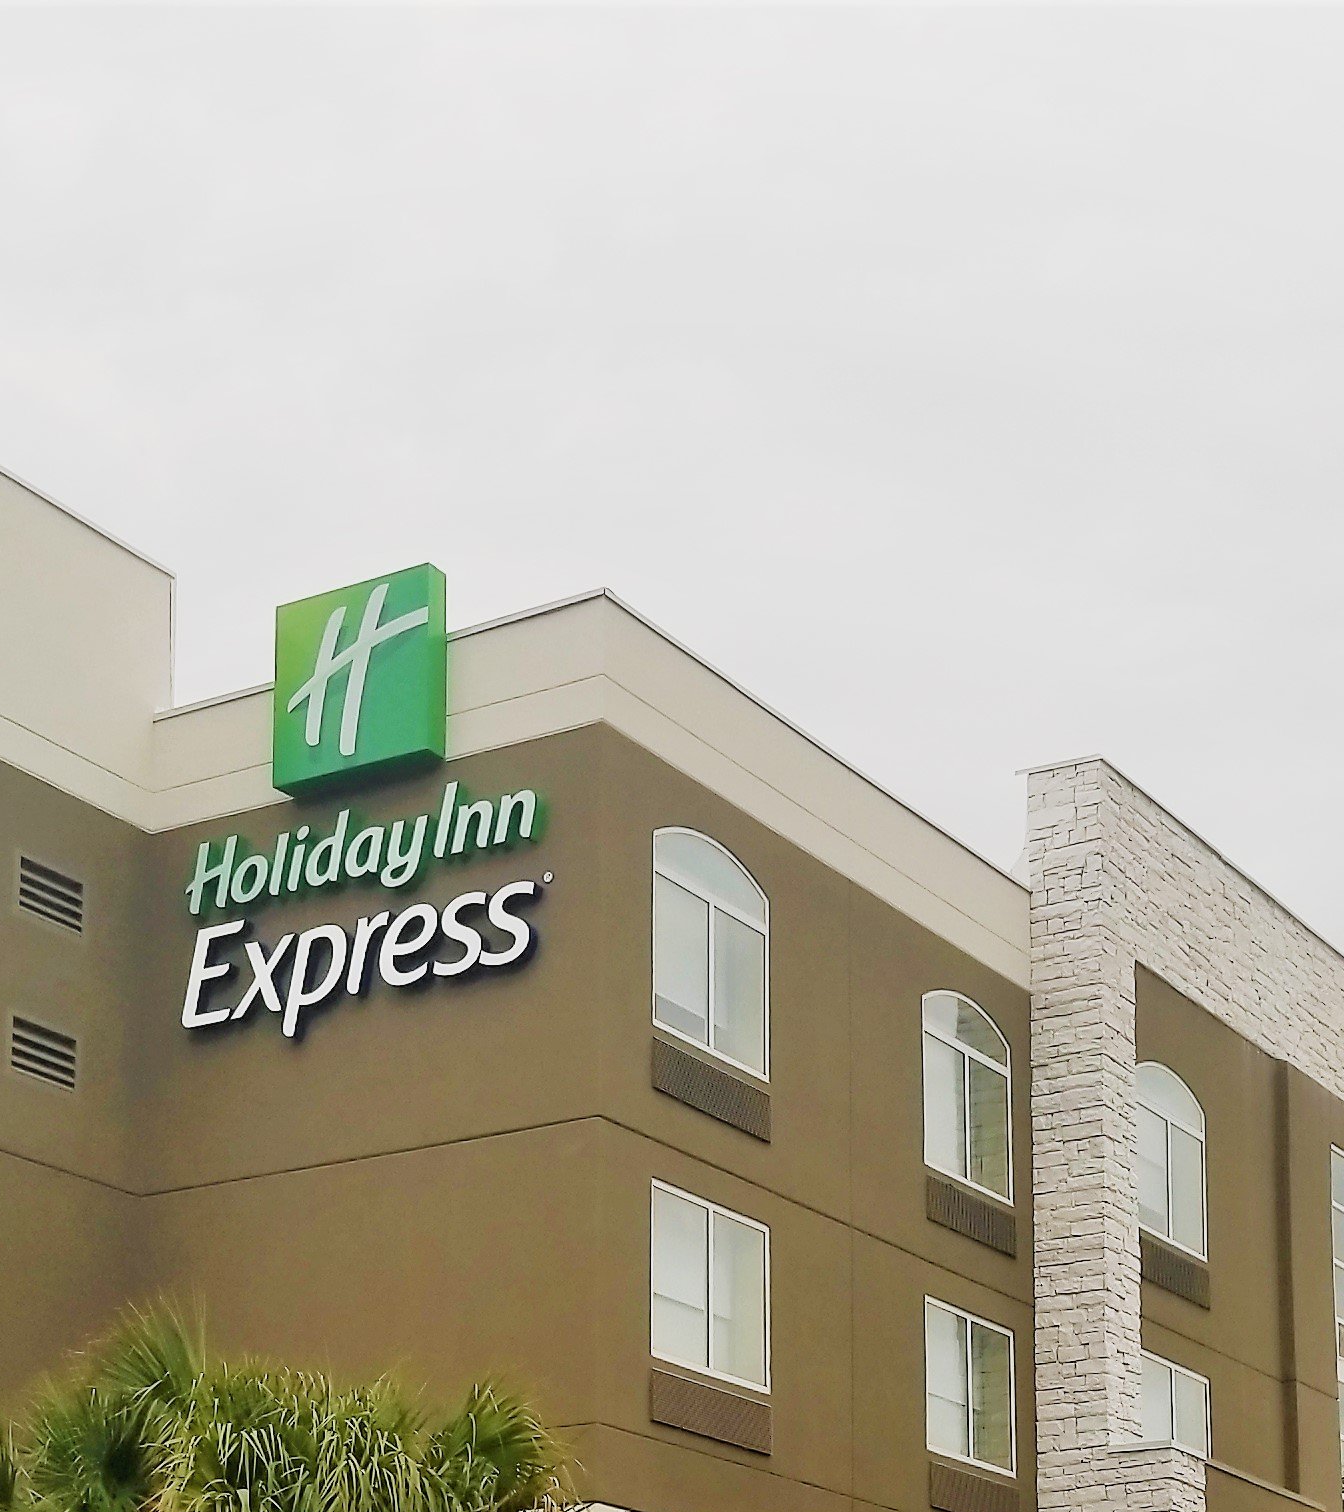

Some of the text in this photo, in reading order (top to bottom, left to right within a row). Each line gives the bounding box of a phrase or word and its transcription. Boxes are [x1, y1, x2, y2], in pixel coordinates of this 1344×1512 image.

[287, 583, 429, 757] H
[184, 781, 538, 915] Holiday Inn
[181, 880, 536, 1038] Express
